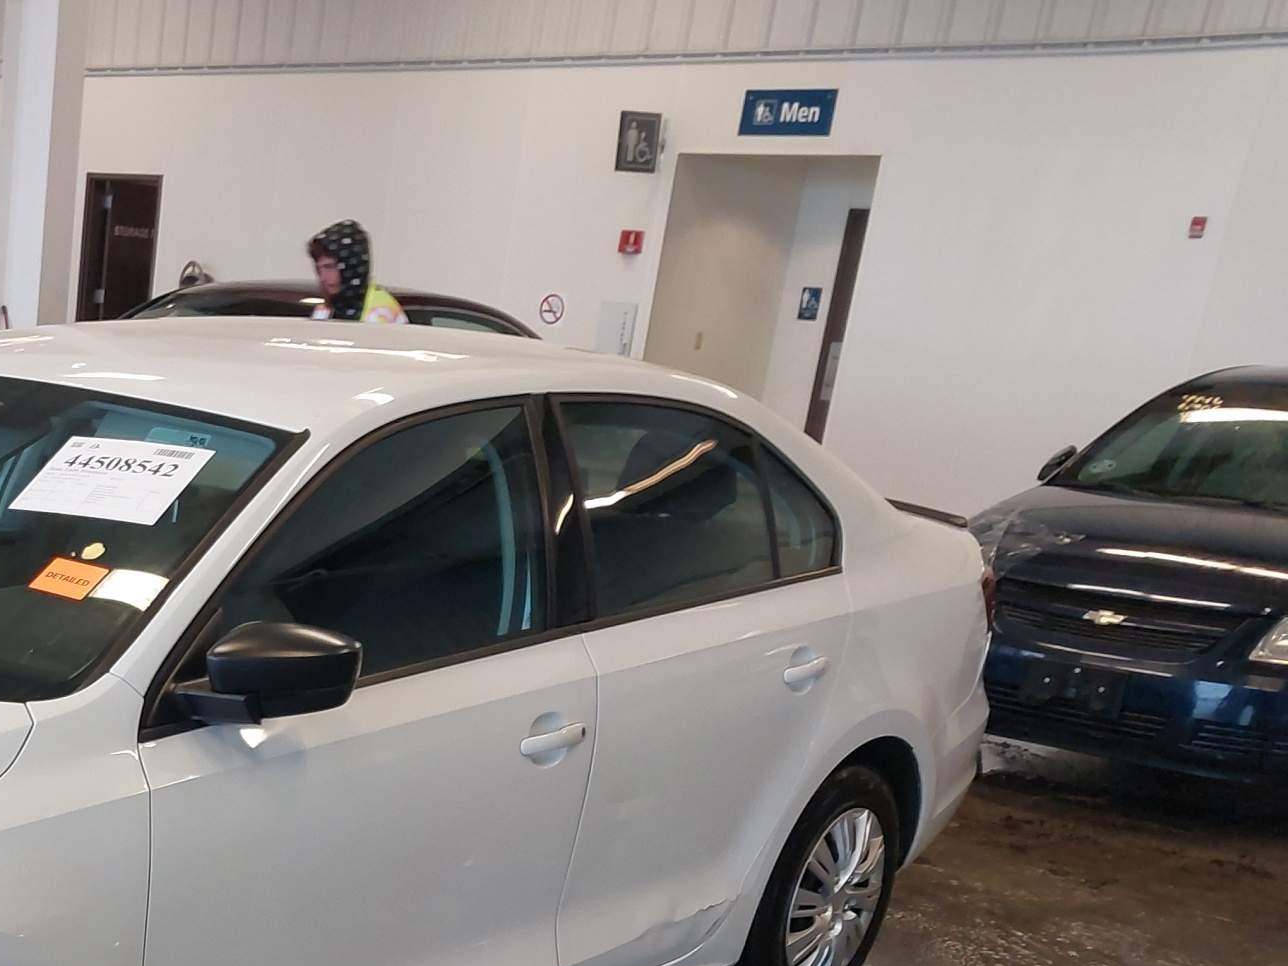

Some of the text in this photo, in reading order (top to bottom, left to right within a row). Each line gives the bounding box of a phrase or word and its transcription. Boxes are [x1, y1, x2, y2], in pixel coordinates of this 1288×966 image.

[779, 101, 820, 123] Men
[64, 454, 180, 477] 44508542
[45, 570, 91, 588] DETAILED
